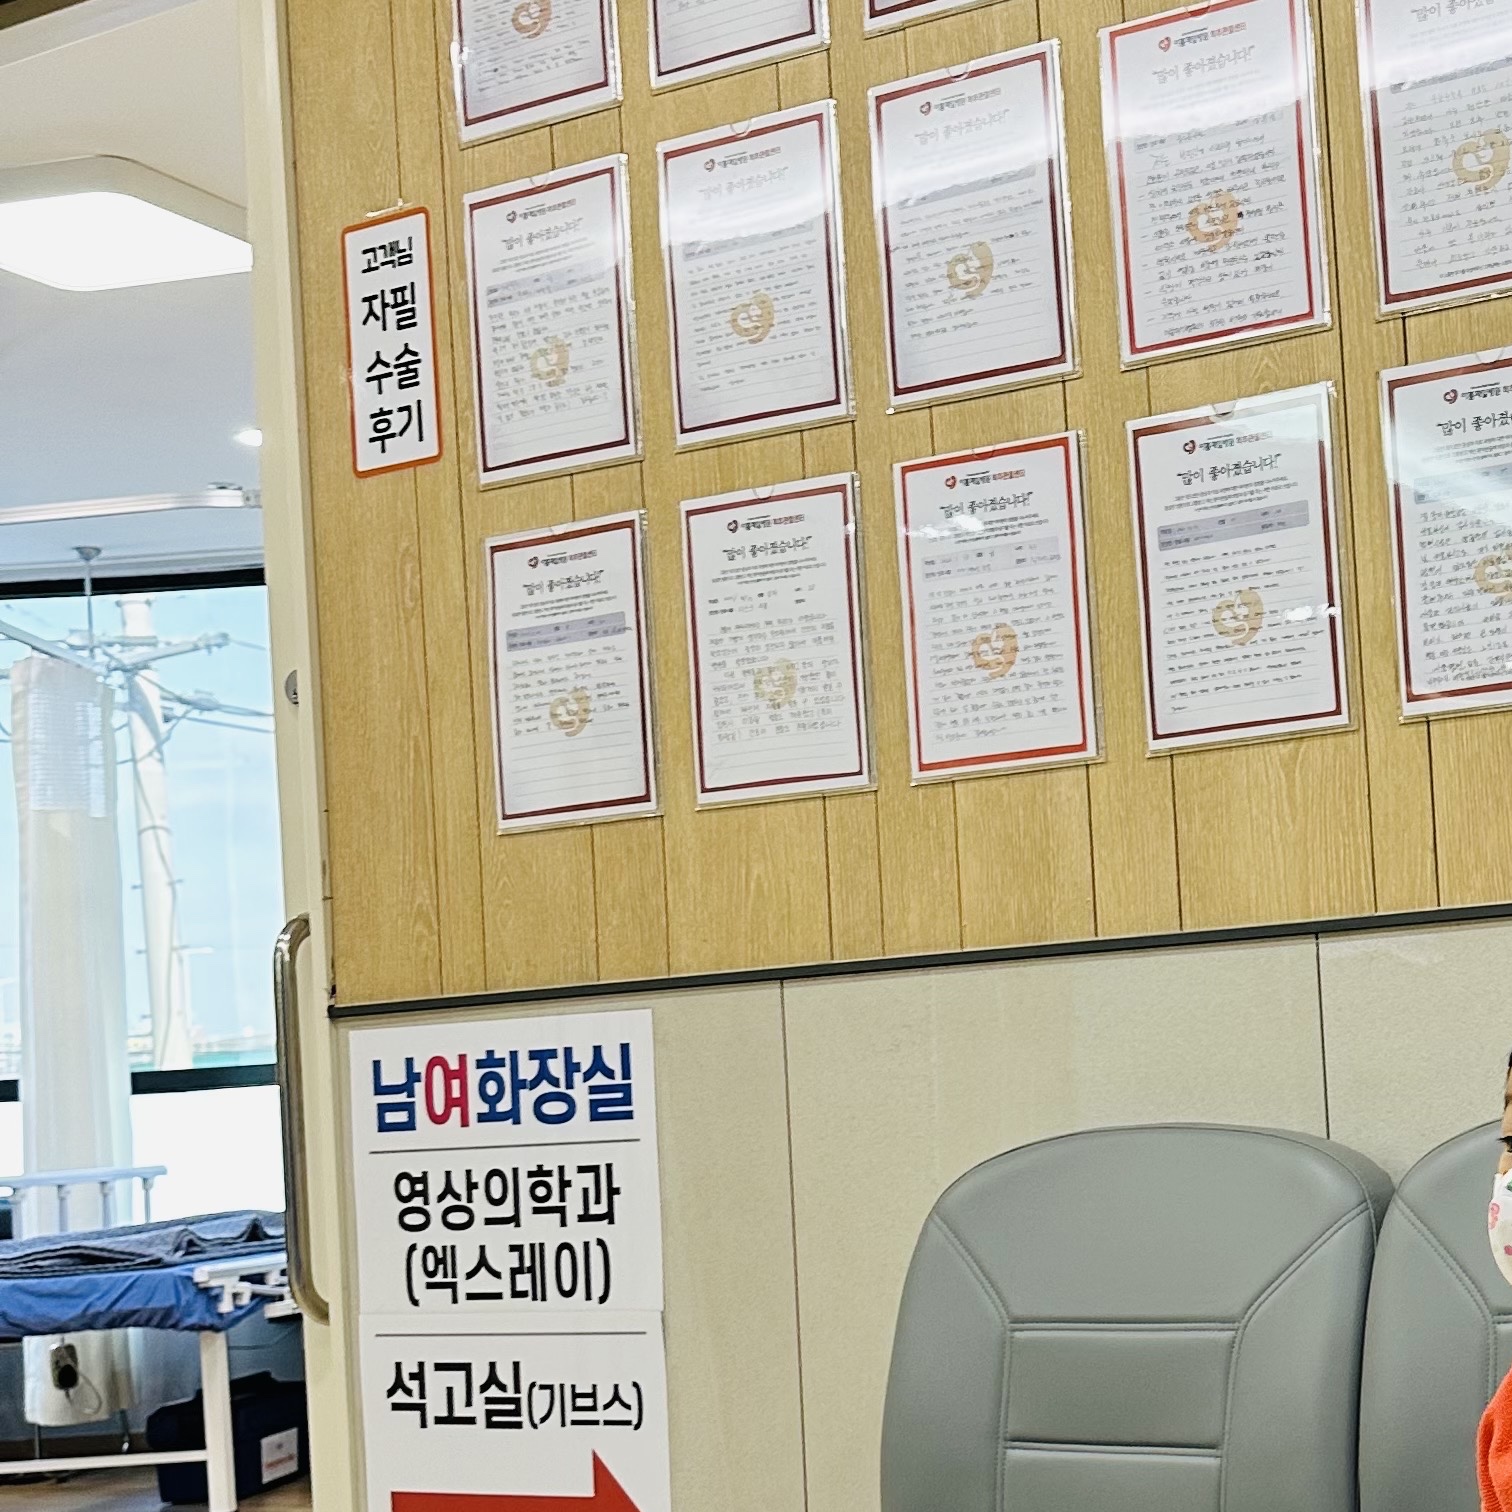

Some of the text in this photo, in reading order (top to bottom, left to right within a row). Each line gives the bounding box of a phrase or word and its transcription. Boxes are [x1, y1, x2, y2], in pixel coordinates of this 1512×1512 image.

[361, 236, 414, 274] 고객님
[361, 281, 418, 332] 자필
[366, 342, 422, 395] 수술
[367, 399, 424, 454] 후기
[370, 1041, 636, 1134] 남여화장실
[393, 1162, 622, 1234] 영상의학과
[405, 1237, 613, 1308] (엑스레이)
[385, 1360, 645, 1432] 석고실(기브스)
